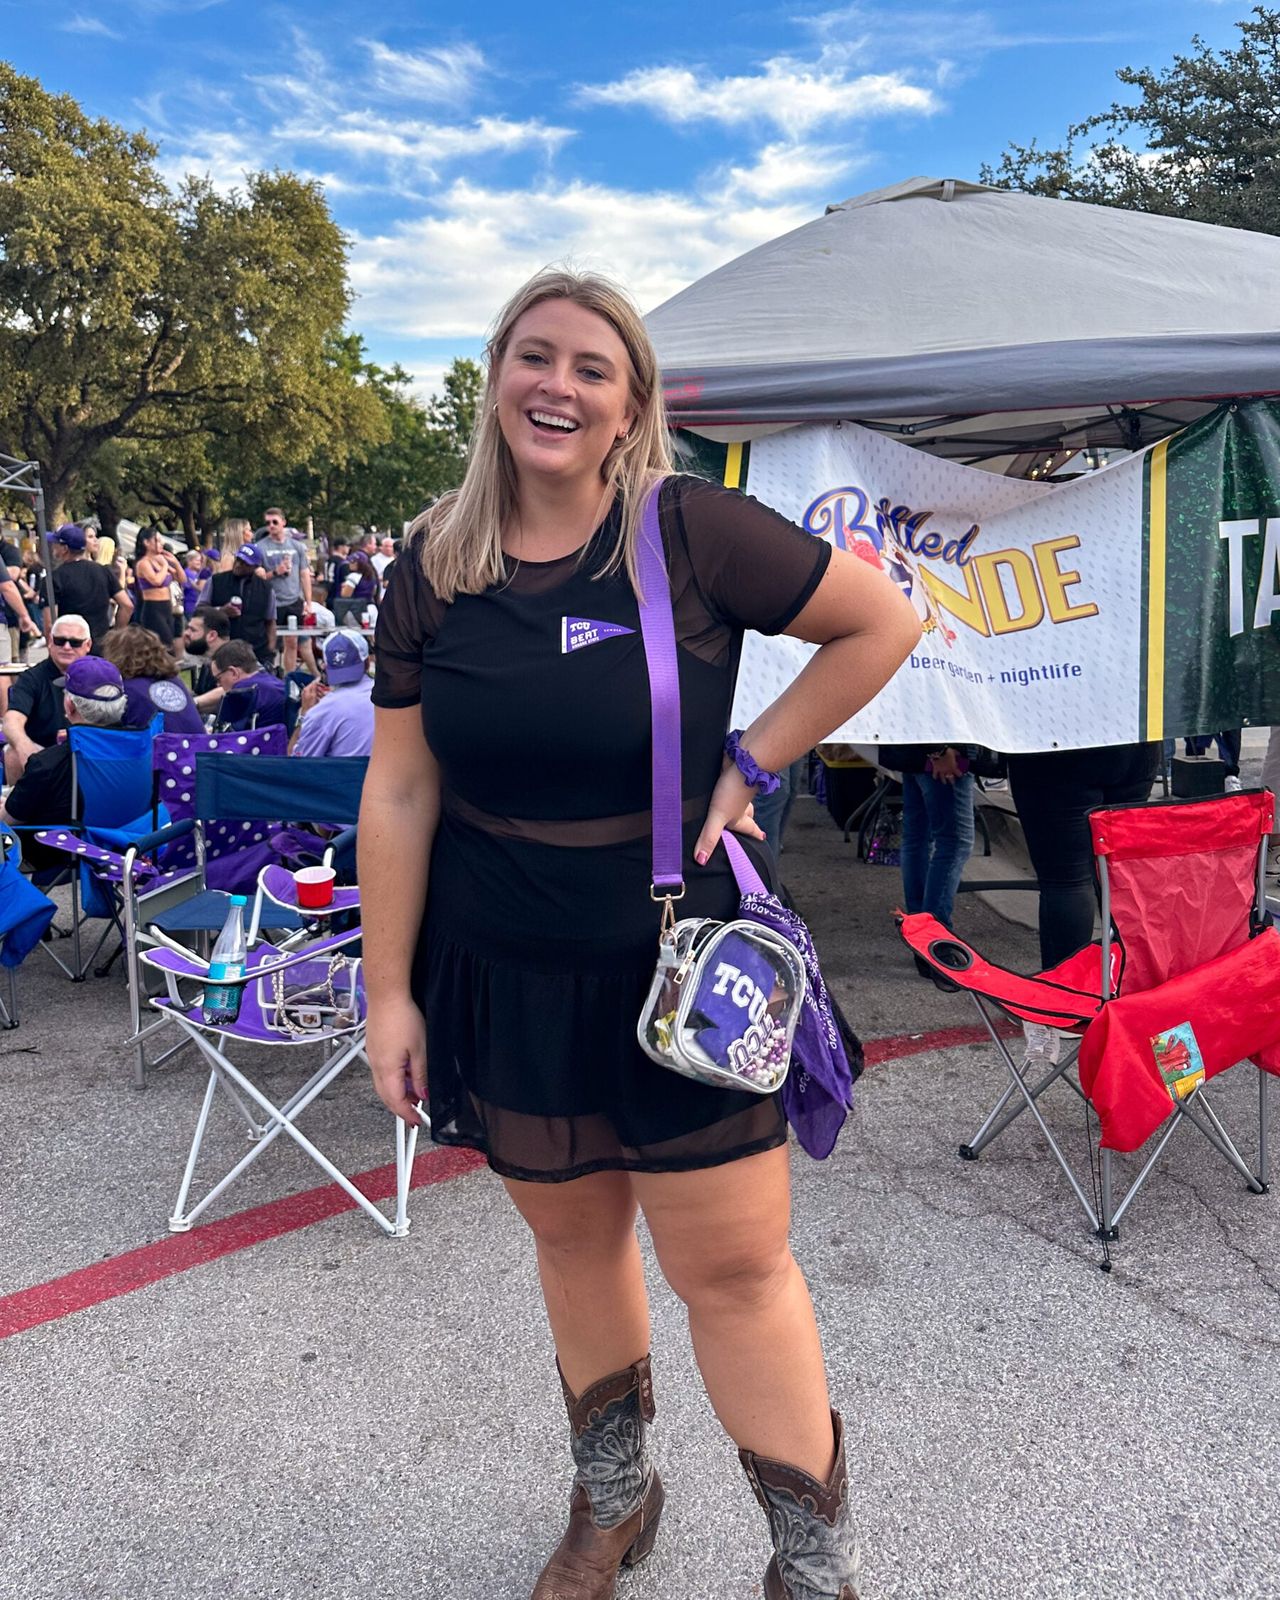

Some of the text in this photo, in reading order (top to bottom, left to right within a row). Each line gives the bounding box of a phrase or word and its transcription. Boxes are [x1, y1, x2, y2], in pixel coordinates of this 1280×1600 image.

[803, 486, 980, 568] Bled
[917, 535, 1100, 638] NDE
[570, 622, 591, 632] TCU
[570, 629, 598, 645] BEAT
[910, 654, 946, 670] beer
[1000, 663, 1083, 686] nightlife
[712, 962, 768, 1026] TCU
